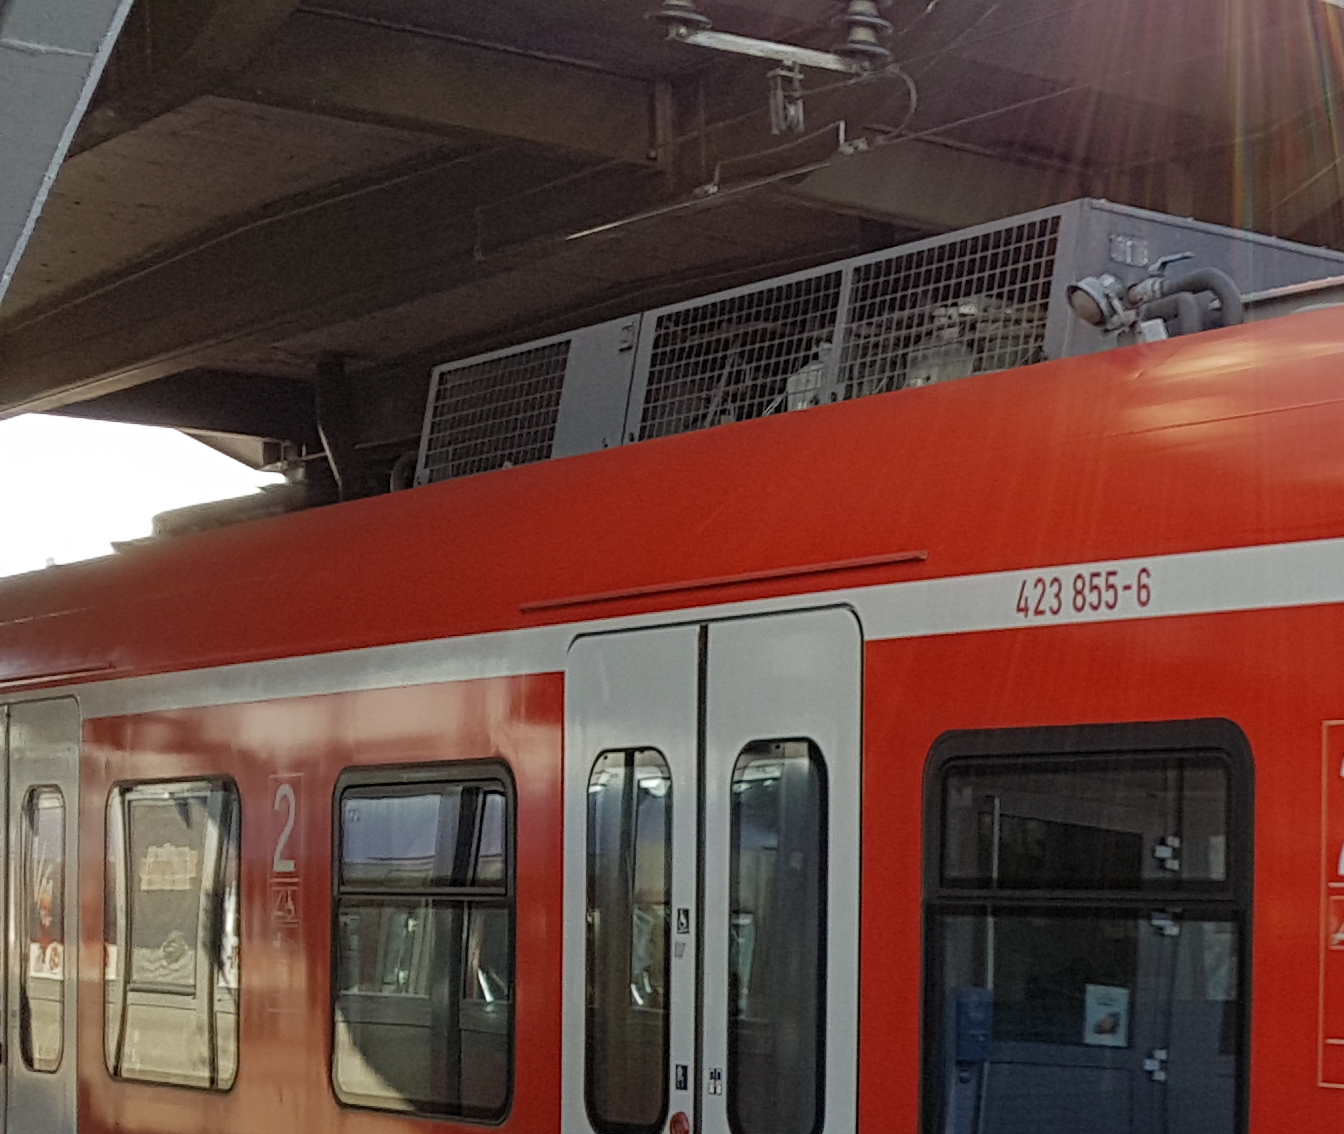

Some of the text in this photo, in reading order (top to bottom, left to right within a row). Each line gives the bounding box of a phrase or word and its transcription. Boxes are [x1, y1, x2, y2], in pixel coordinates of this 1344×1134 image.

[1015, 567, 1152, 619] 423 855-6
[272, 782, 297, 873] 2
